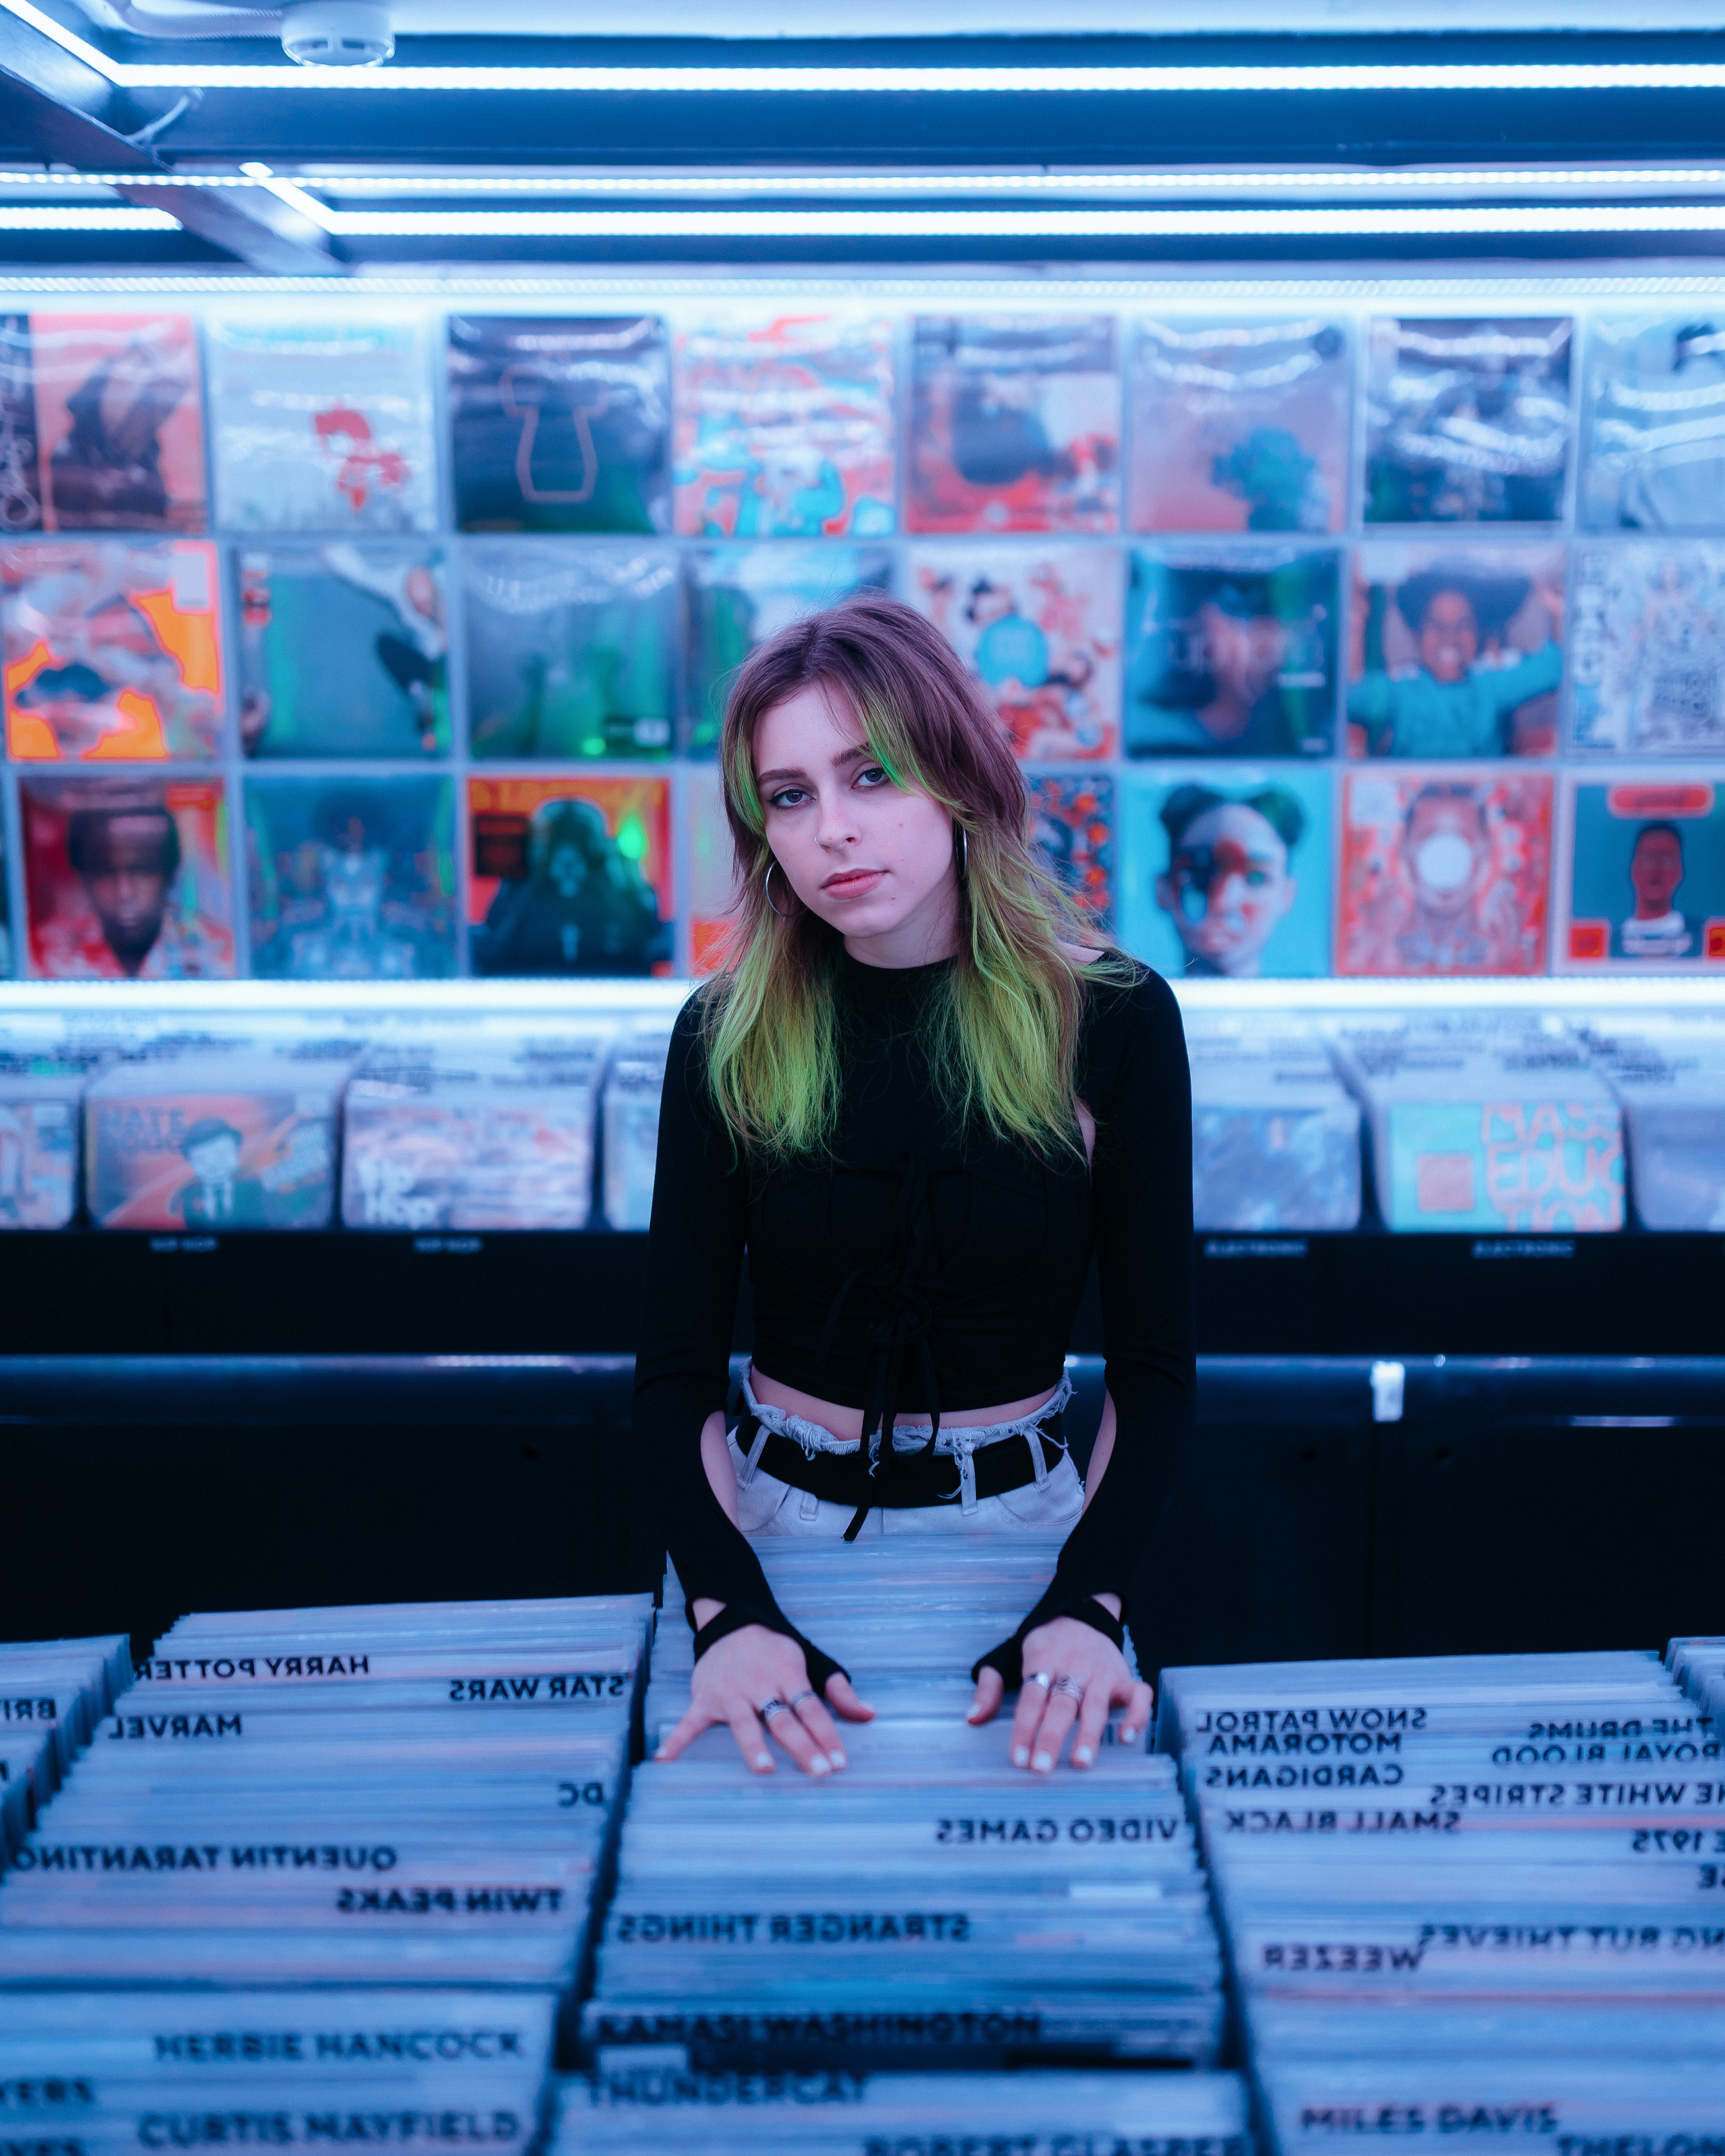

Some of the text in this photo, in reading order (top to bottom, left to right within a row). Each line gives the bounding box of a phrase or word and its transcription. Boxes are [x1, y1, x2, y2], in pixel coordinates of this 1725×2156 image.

[153, 2032, 524, 2062] HERBIE HANCOCK
[588, 2070, 868, 2107] THUNDERCAT
[139, 2110, 520, 2147] CURTIS MAYFIELD
[1300, 2102, 1557, 2134] MILES DAVIS
